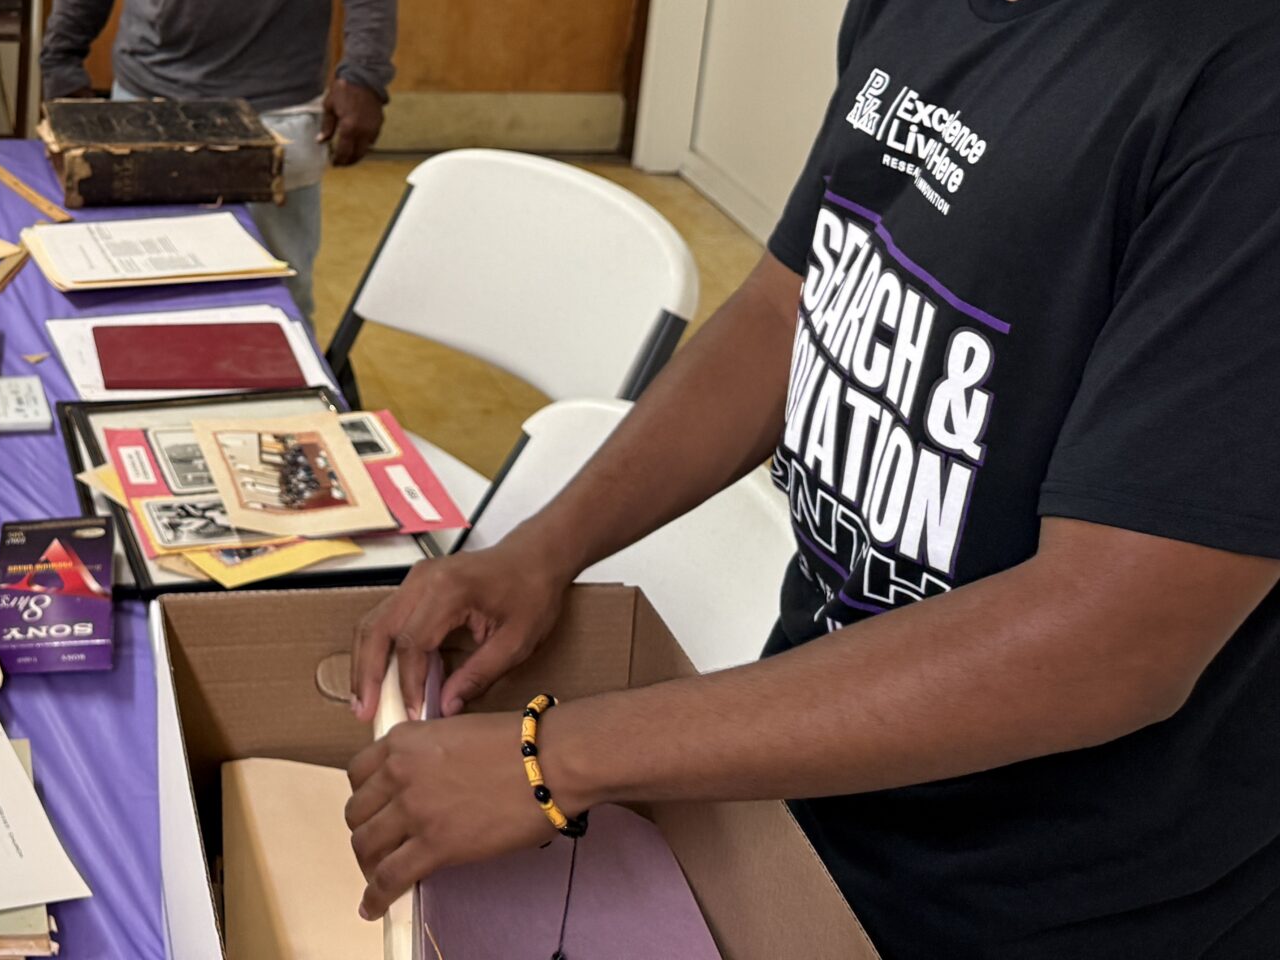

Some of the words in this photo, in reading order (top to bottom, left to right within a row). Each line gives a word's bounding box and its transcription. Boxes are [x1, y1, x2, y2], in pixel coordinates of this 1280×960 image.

[927, 144, 964, 193] Here
[926, 329, 994, 464] &
[2, 622, 93, 640] SONY
